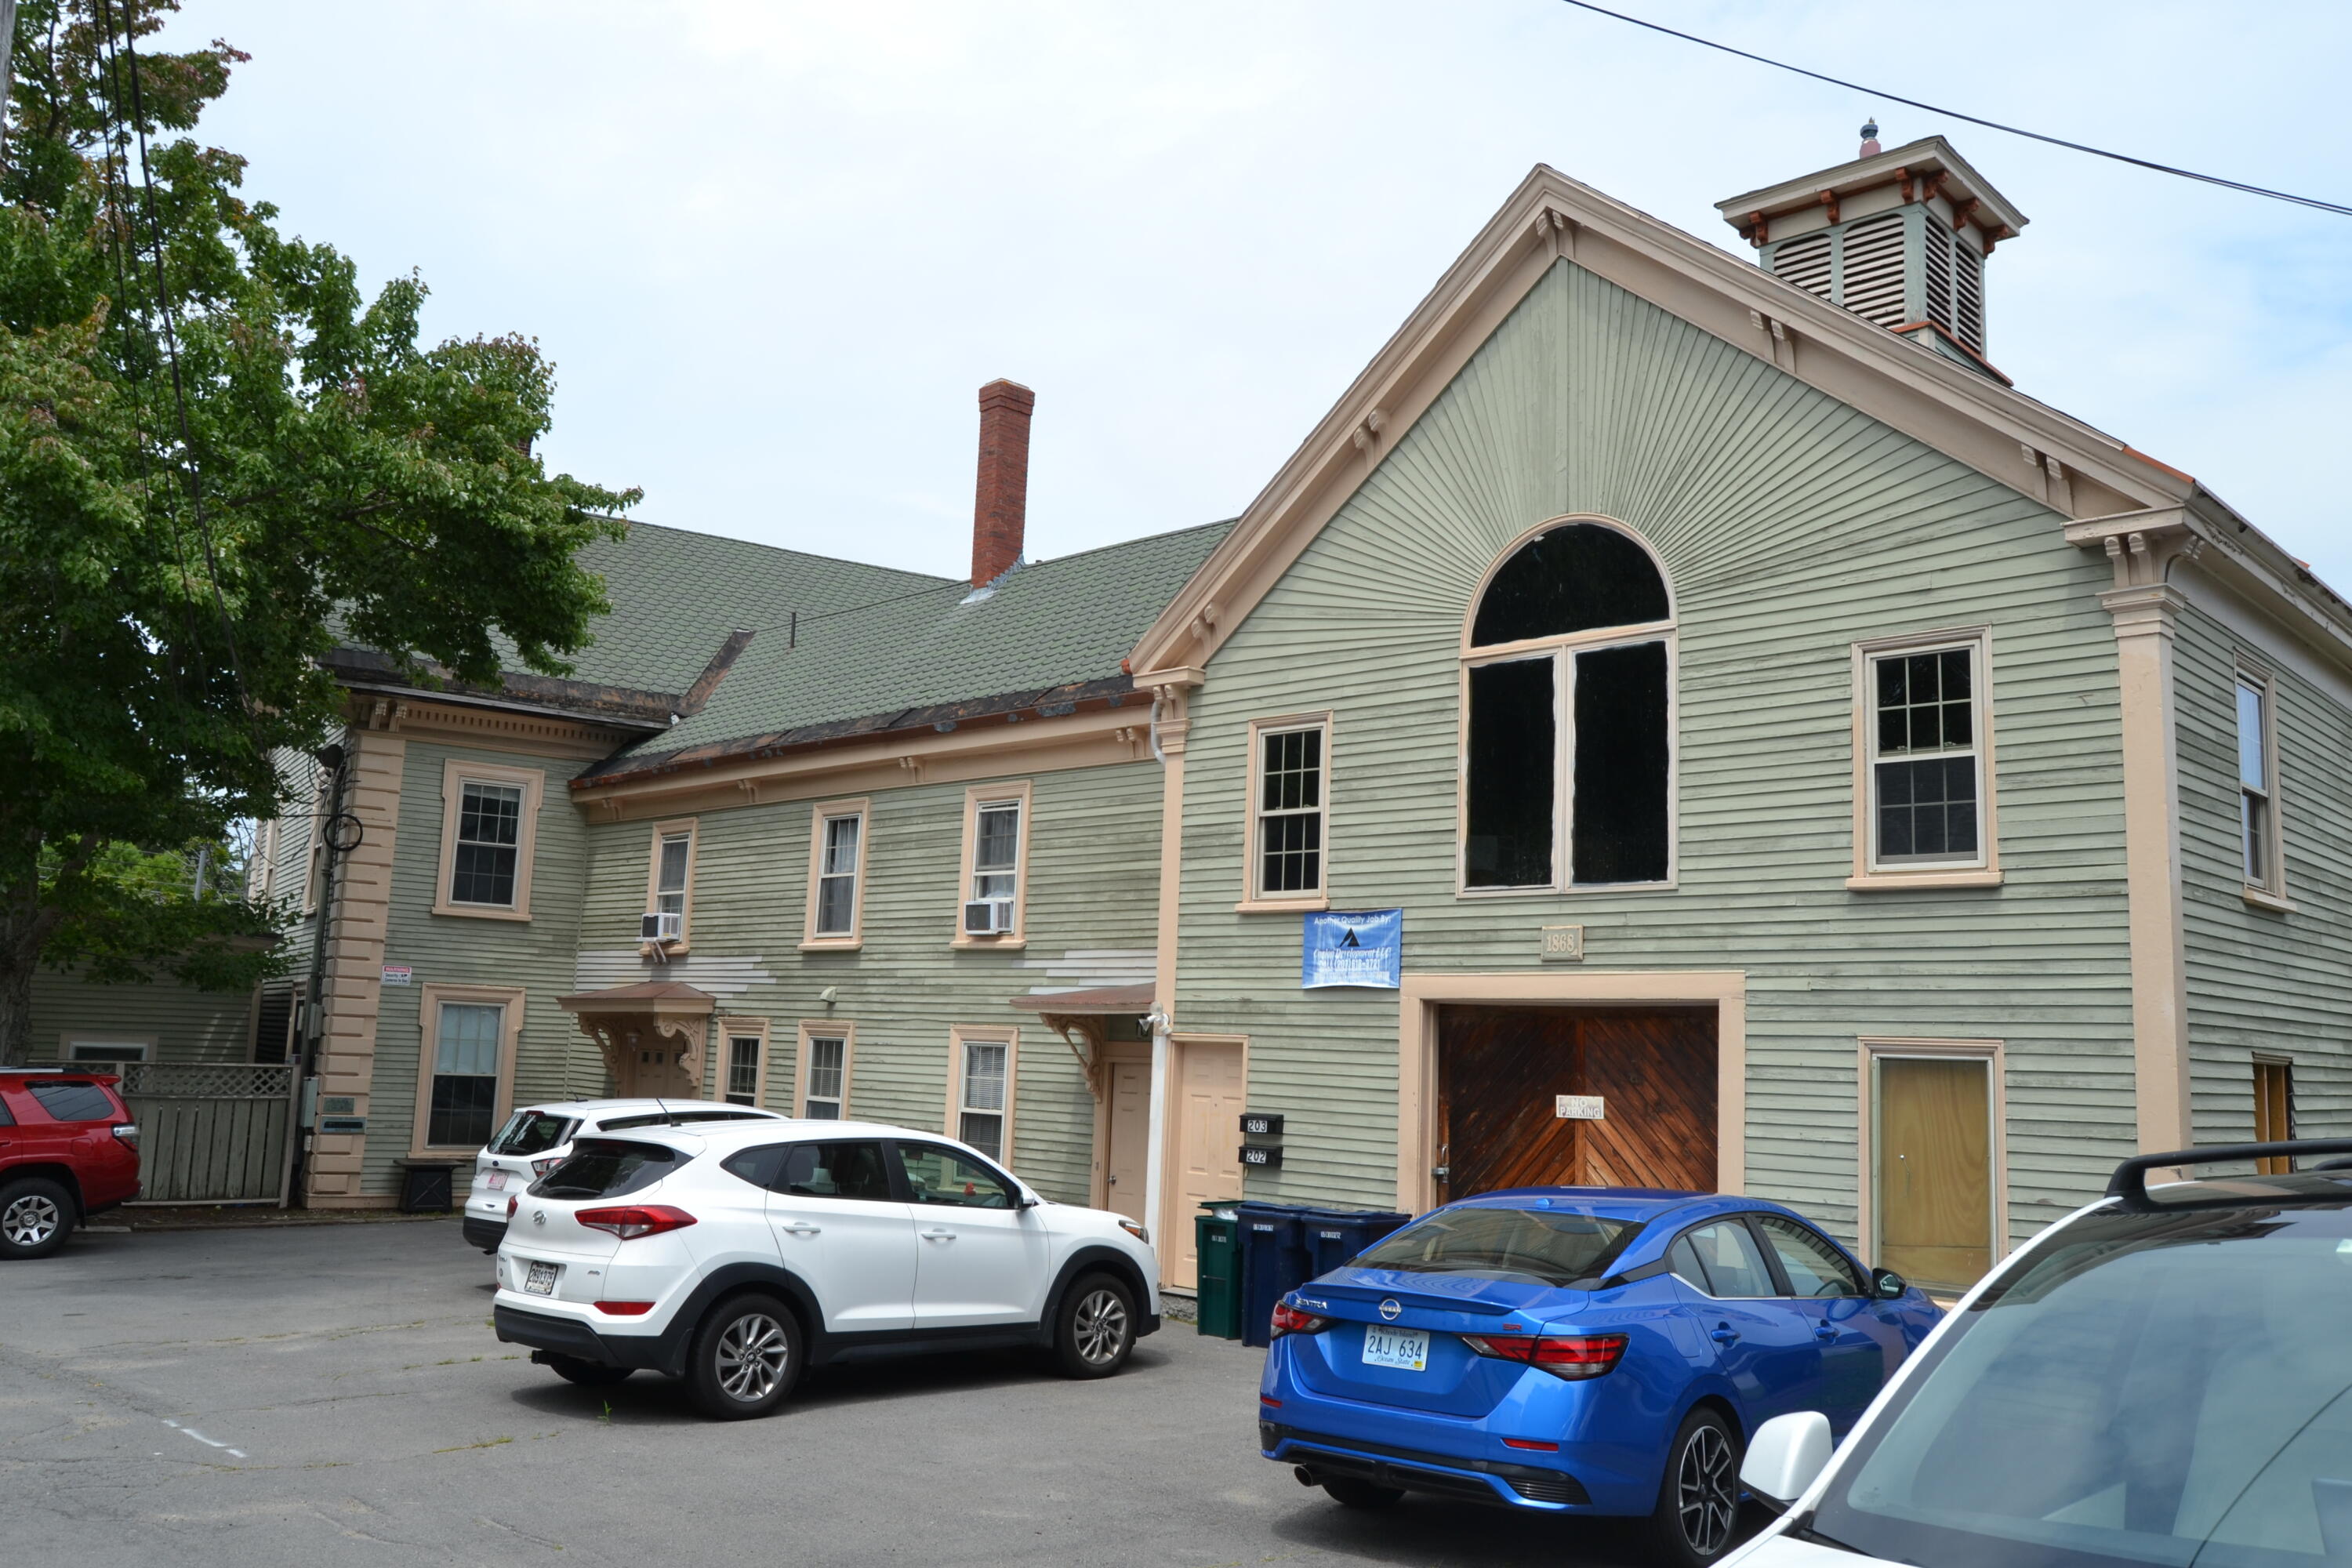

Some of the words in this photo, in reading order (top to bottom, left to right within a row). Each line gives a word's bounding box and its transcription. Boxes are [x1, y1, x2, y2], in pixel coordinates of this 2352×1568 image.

[1341, 915, 1365, 924] Quality
[1546, 934, 1574, 953] 1868
[1376, 946, 1392, 958] LLC
[1572, 1098, 1588, 1107] NO
[1560, 1106, 1600, 1117] PARKING
[1248, 1120, 1266, 1132] 203
[1247, 1150, 1265, 1162] 202
[1296, 1298, 1327, 1309] SENTRA
[1367, 1335, 1392, 1355] 2AJ
[1399, 1339, 1423, 1359] 634
